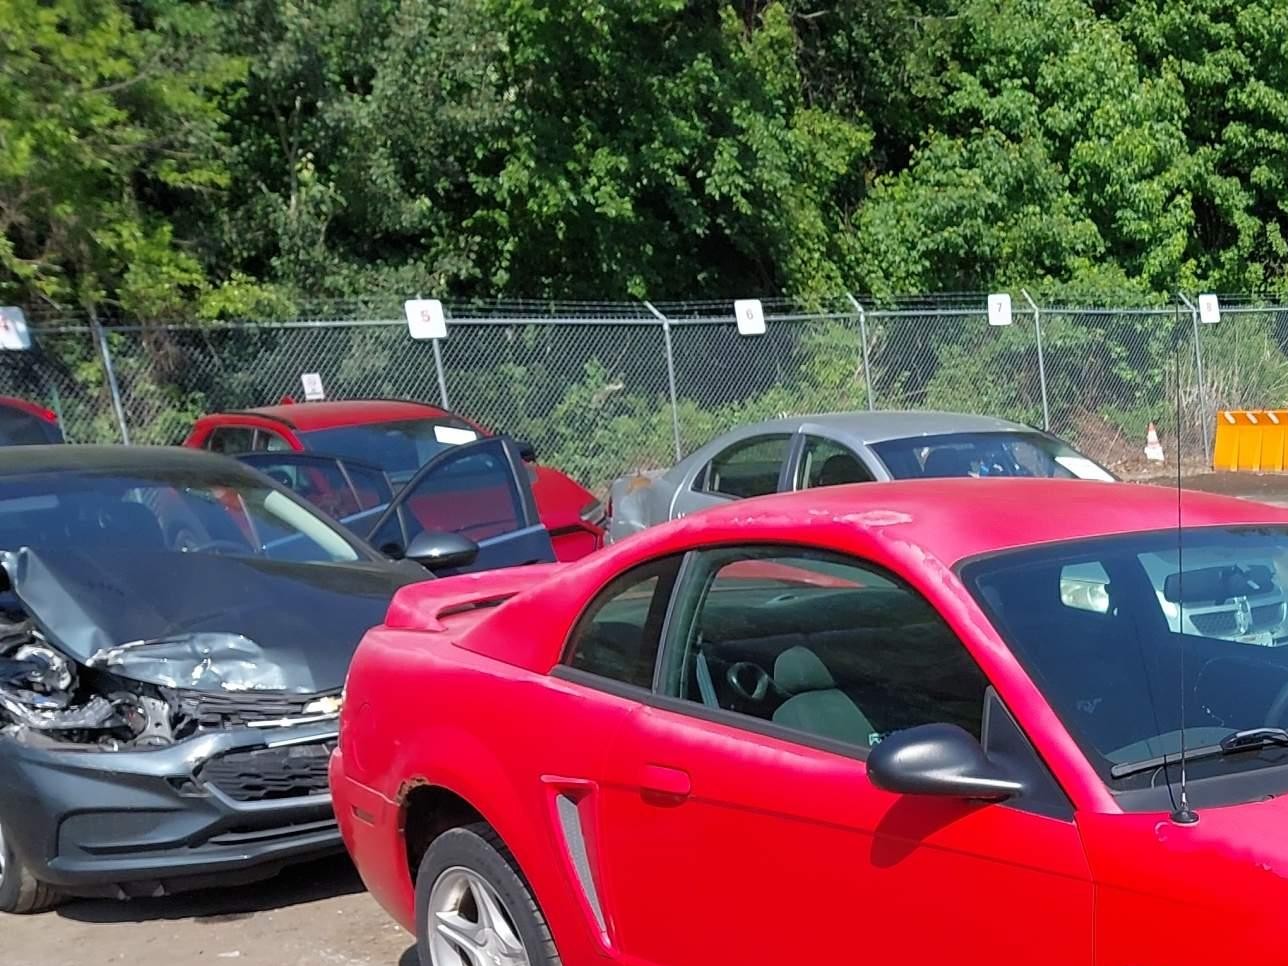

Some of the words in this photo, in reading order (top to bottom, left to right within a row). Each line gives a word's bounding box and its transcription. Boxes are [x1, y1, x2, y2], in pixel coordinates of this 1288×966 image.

[996, 302, 1004, 313] 7
[420, 310, 431, 322] 5
[745, 308, 754, 320] 6
